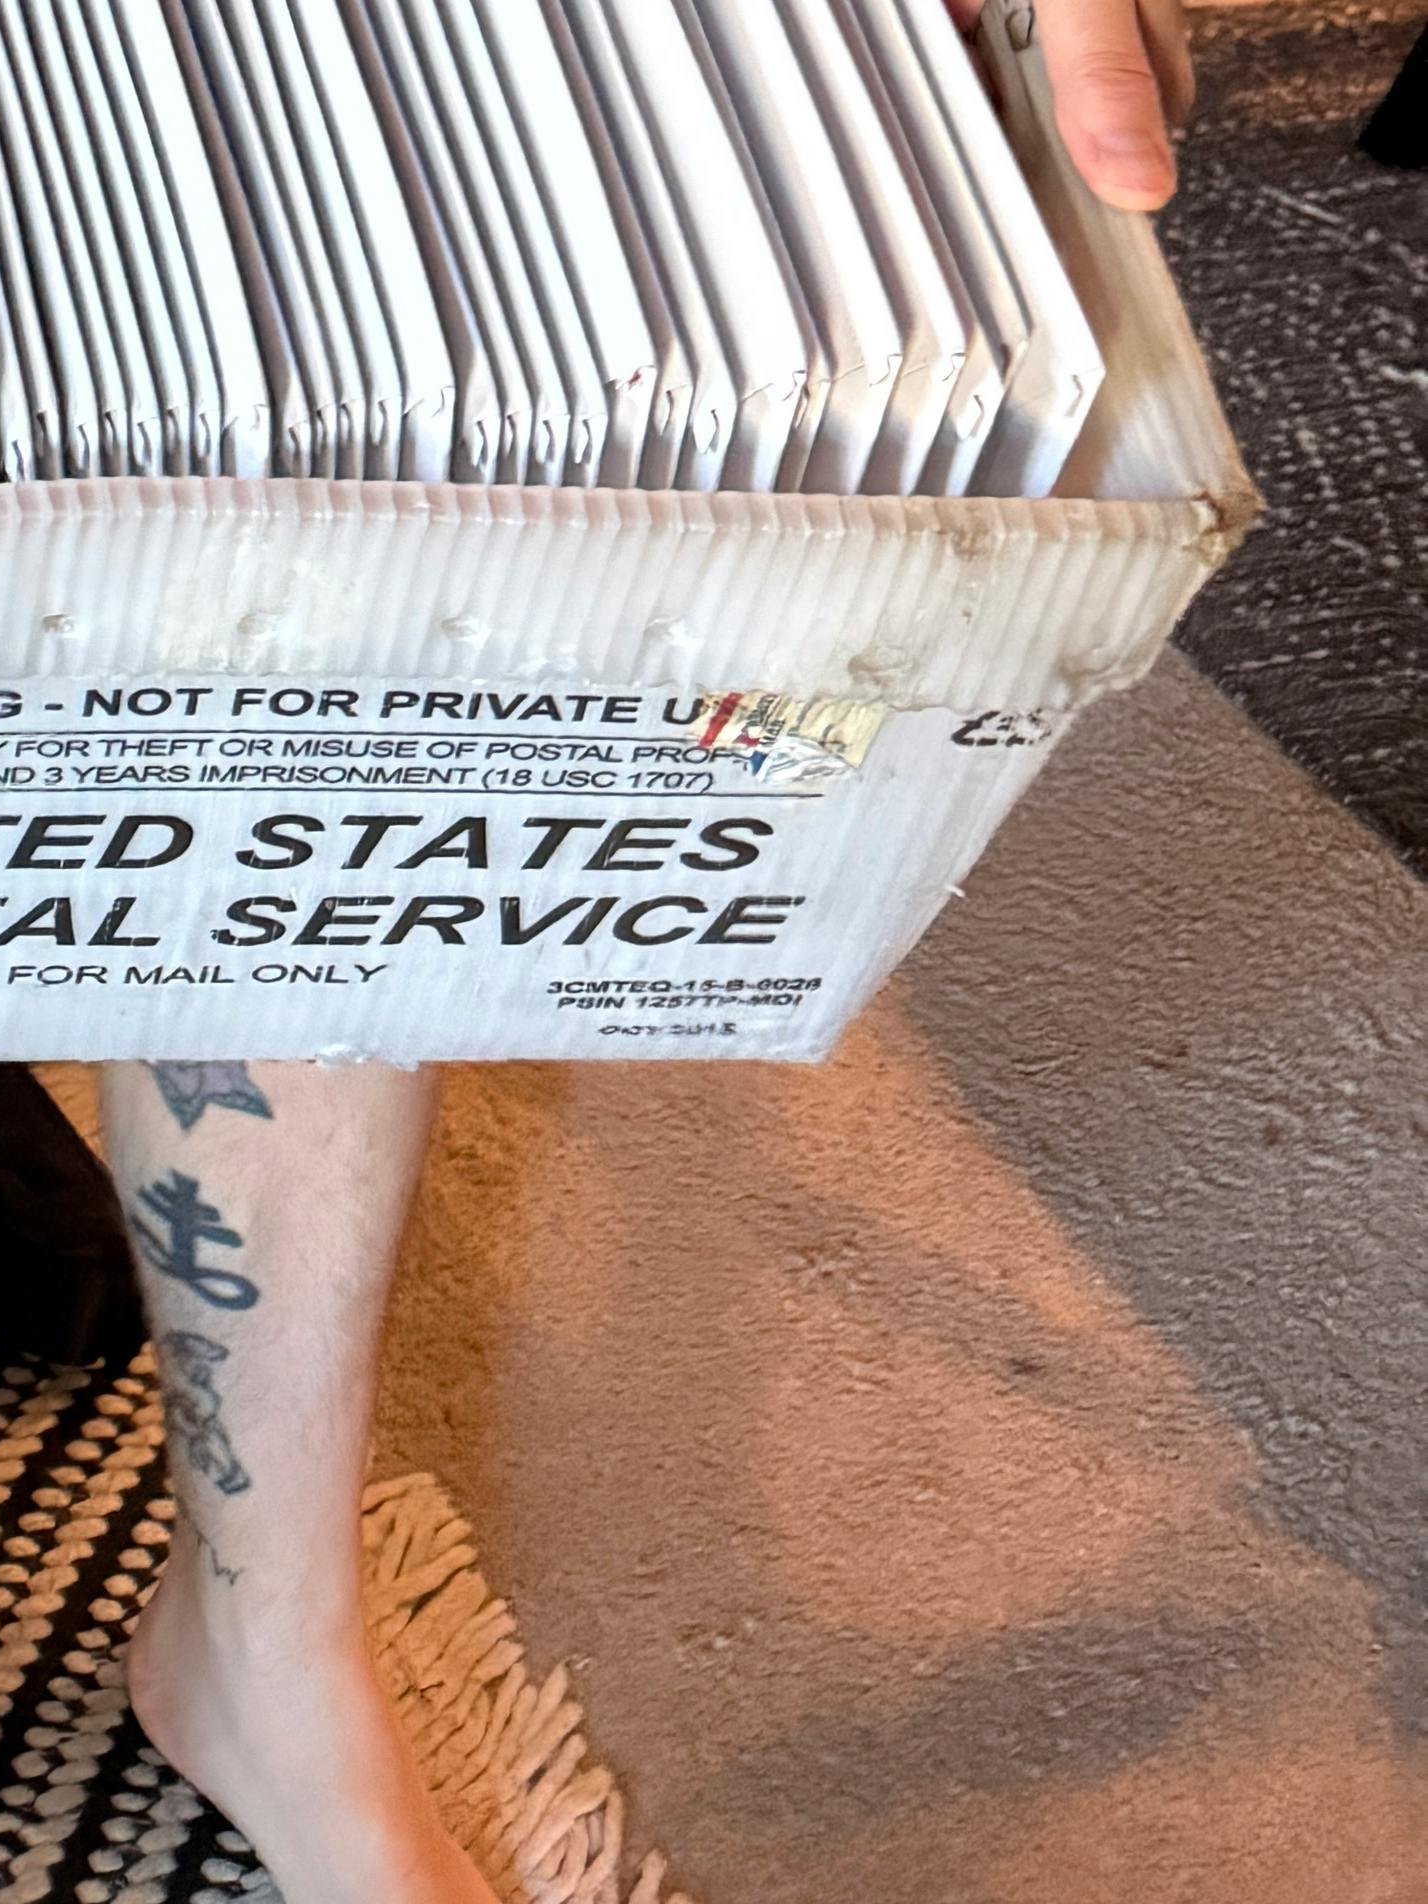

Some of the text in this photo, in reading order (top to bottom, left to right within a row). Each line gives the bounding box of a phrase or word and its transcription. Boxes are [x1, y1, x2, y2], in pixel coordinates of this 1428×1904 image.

[82, 687, 214, 718] NOT
[230, 688, 362, 718] FOR
[379, 691, 643, 725] PRIVATE
[15, 739, 90, 759] FOR
[97, 738, 213, 759] THEFT
[219, 738, 274, 759] OR
[281, 738, 417, 760] MISUSE
[429, 740, 480, 761] OF
[484, 741, 624, 763] POSTAL
[44, 765, 63, 785] 3
[70, 764, 191, 784] YEARS
[196, 765, 477, 788] IMPRISONMENT
[481, 767, 534, 790] (18
[541, 767, 619, 789] USC
[625, 768, 716, 793] 1707)
[234, 813, 776, 873] STATES
[210, 894, 807, 947] SERVICE
[6, 962, 390, 986] FOR MAIL ONLY
